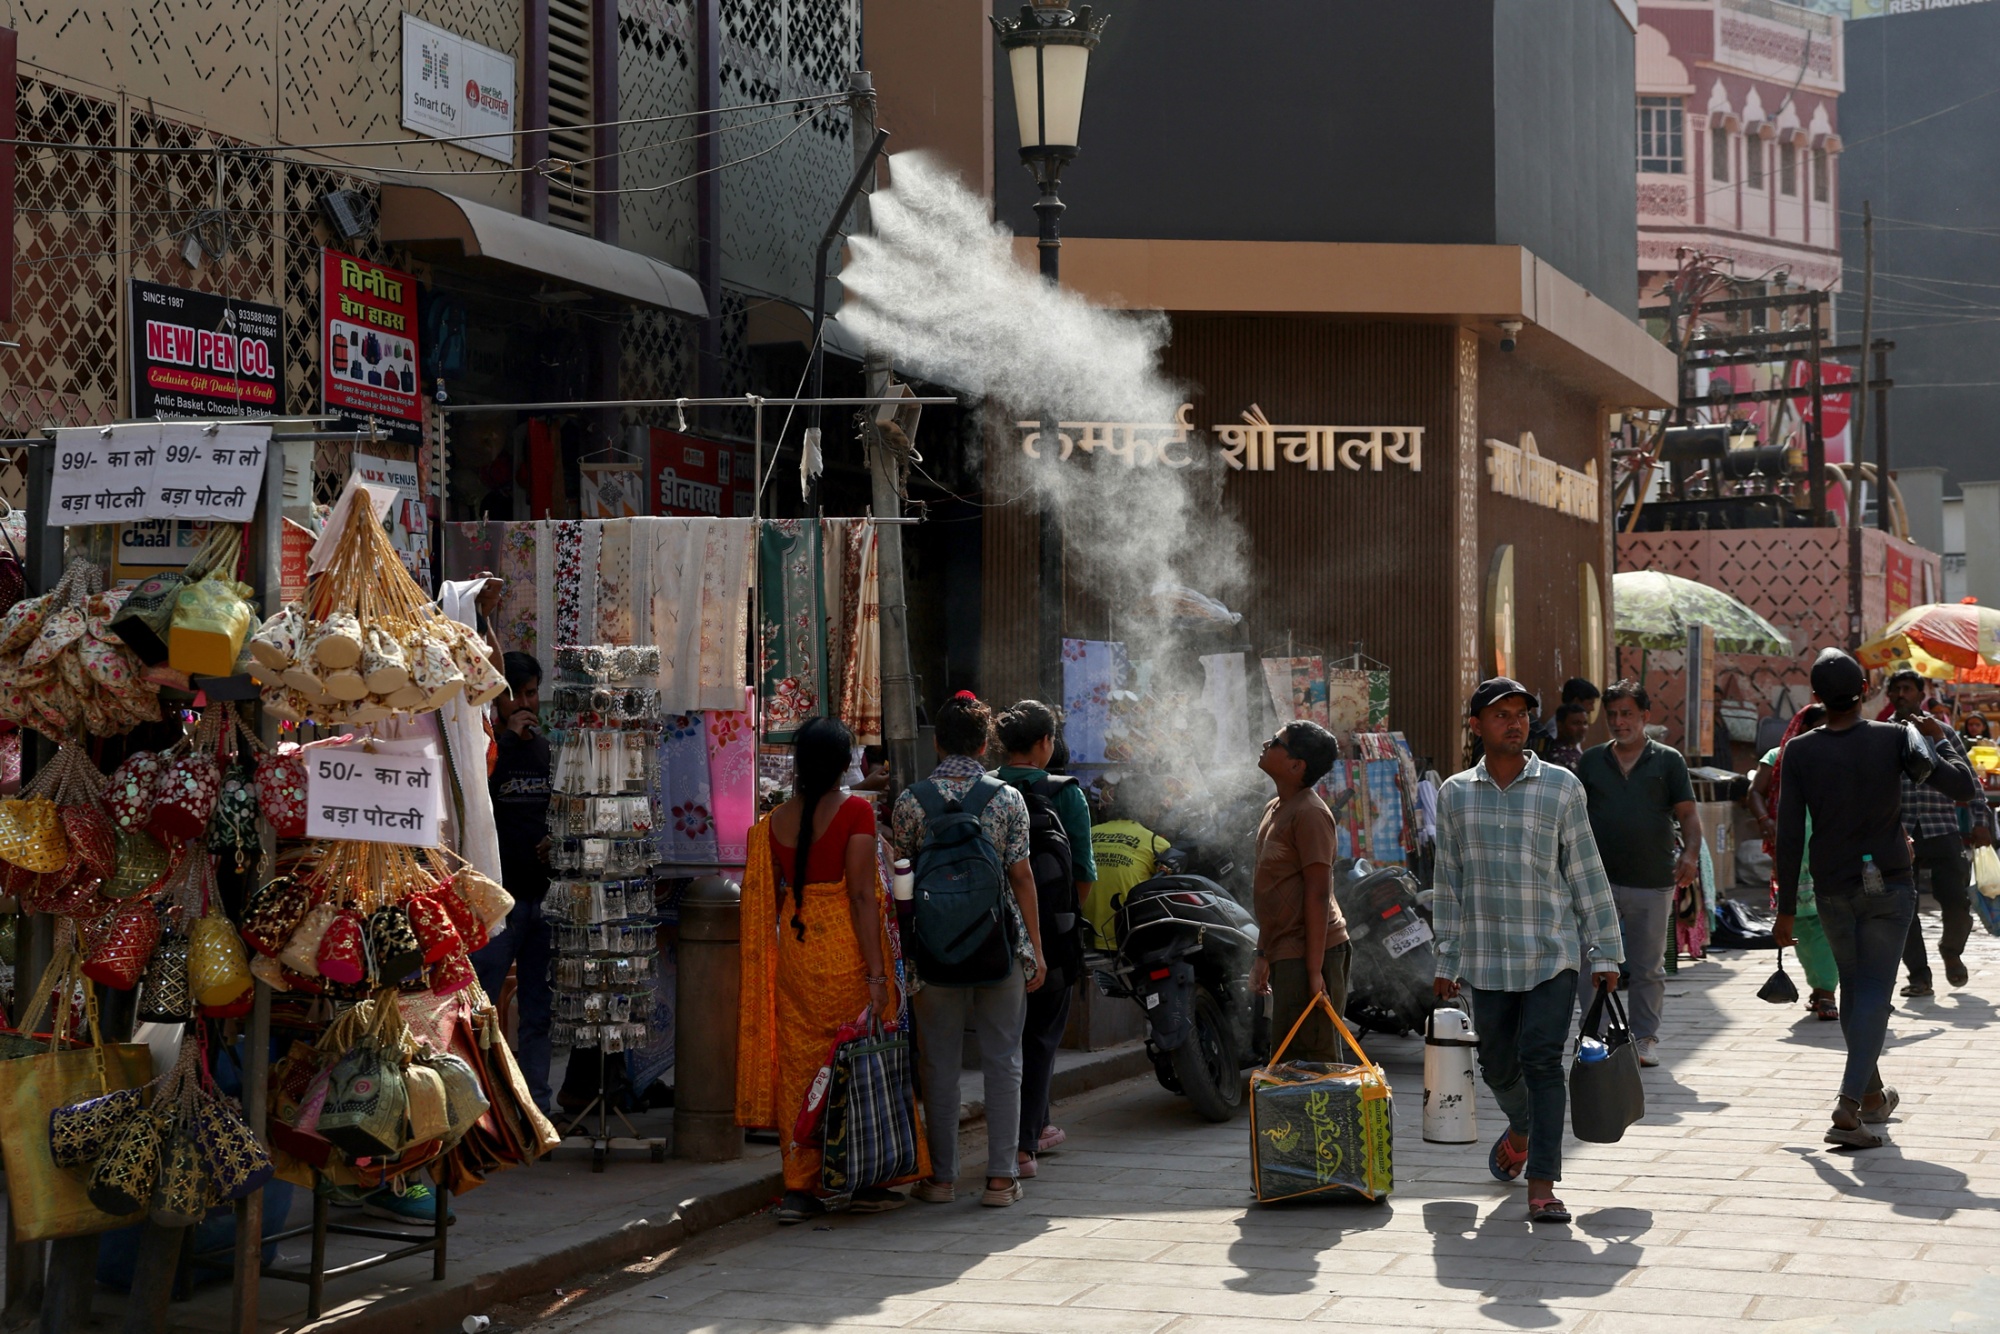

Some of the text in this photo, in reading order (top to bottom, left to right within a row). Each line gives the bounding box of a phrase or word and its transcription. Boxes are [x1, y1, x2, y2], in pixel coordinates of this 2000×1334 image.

[1889, 0, 1992, 15] RESTAU
[414, 92, 439, 114] Smart
[440, 102, 457, 121] City
[480, 93, 510, 116] वाराणसी
[341, 259, 402, 304] विनीत
[142, 291, 184, 308] SINCE 1987
[338, 292, 405, 331] बैग हाउस
[146, 320, 275, 379] NEW PEN CO.
[151, 370, 273, 401] Exclusive Gift Packing & Craft
[154, 393, 175, 406] Antic
[177, 396, 206, 412] Basket,
[207, 401, 245, 416] Chocoles
[1016, 402, 1425, 472] कम्फर्ट शौचालय
[61, 446, 155, 470] 99/- का लो
[165, 445, 261, 466] 99/- का लो
[387, 472, 416, 486] VENUS
[658, 466, 723, 516] डीलक्स
[61, 486, 146, 514] बड़ा पोटली
[160, 484, 246, 508] बड़ा पोटली
[122, 529, 171, 547] Chaal
[318, 760, 431, 788] 50/- का लो
[322, 804, 424, 830] बड़ा पोटली
[1374, 1098, 1383, 1123] वाराणस
